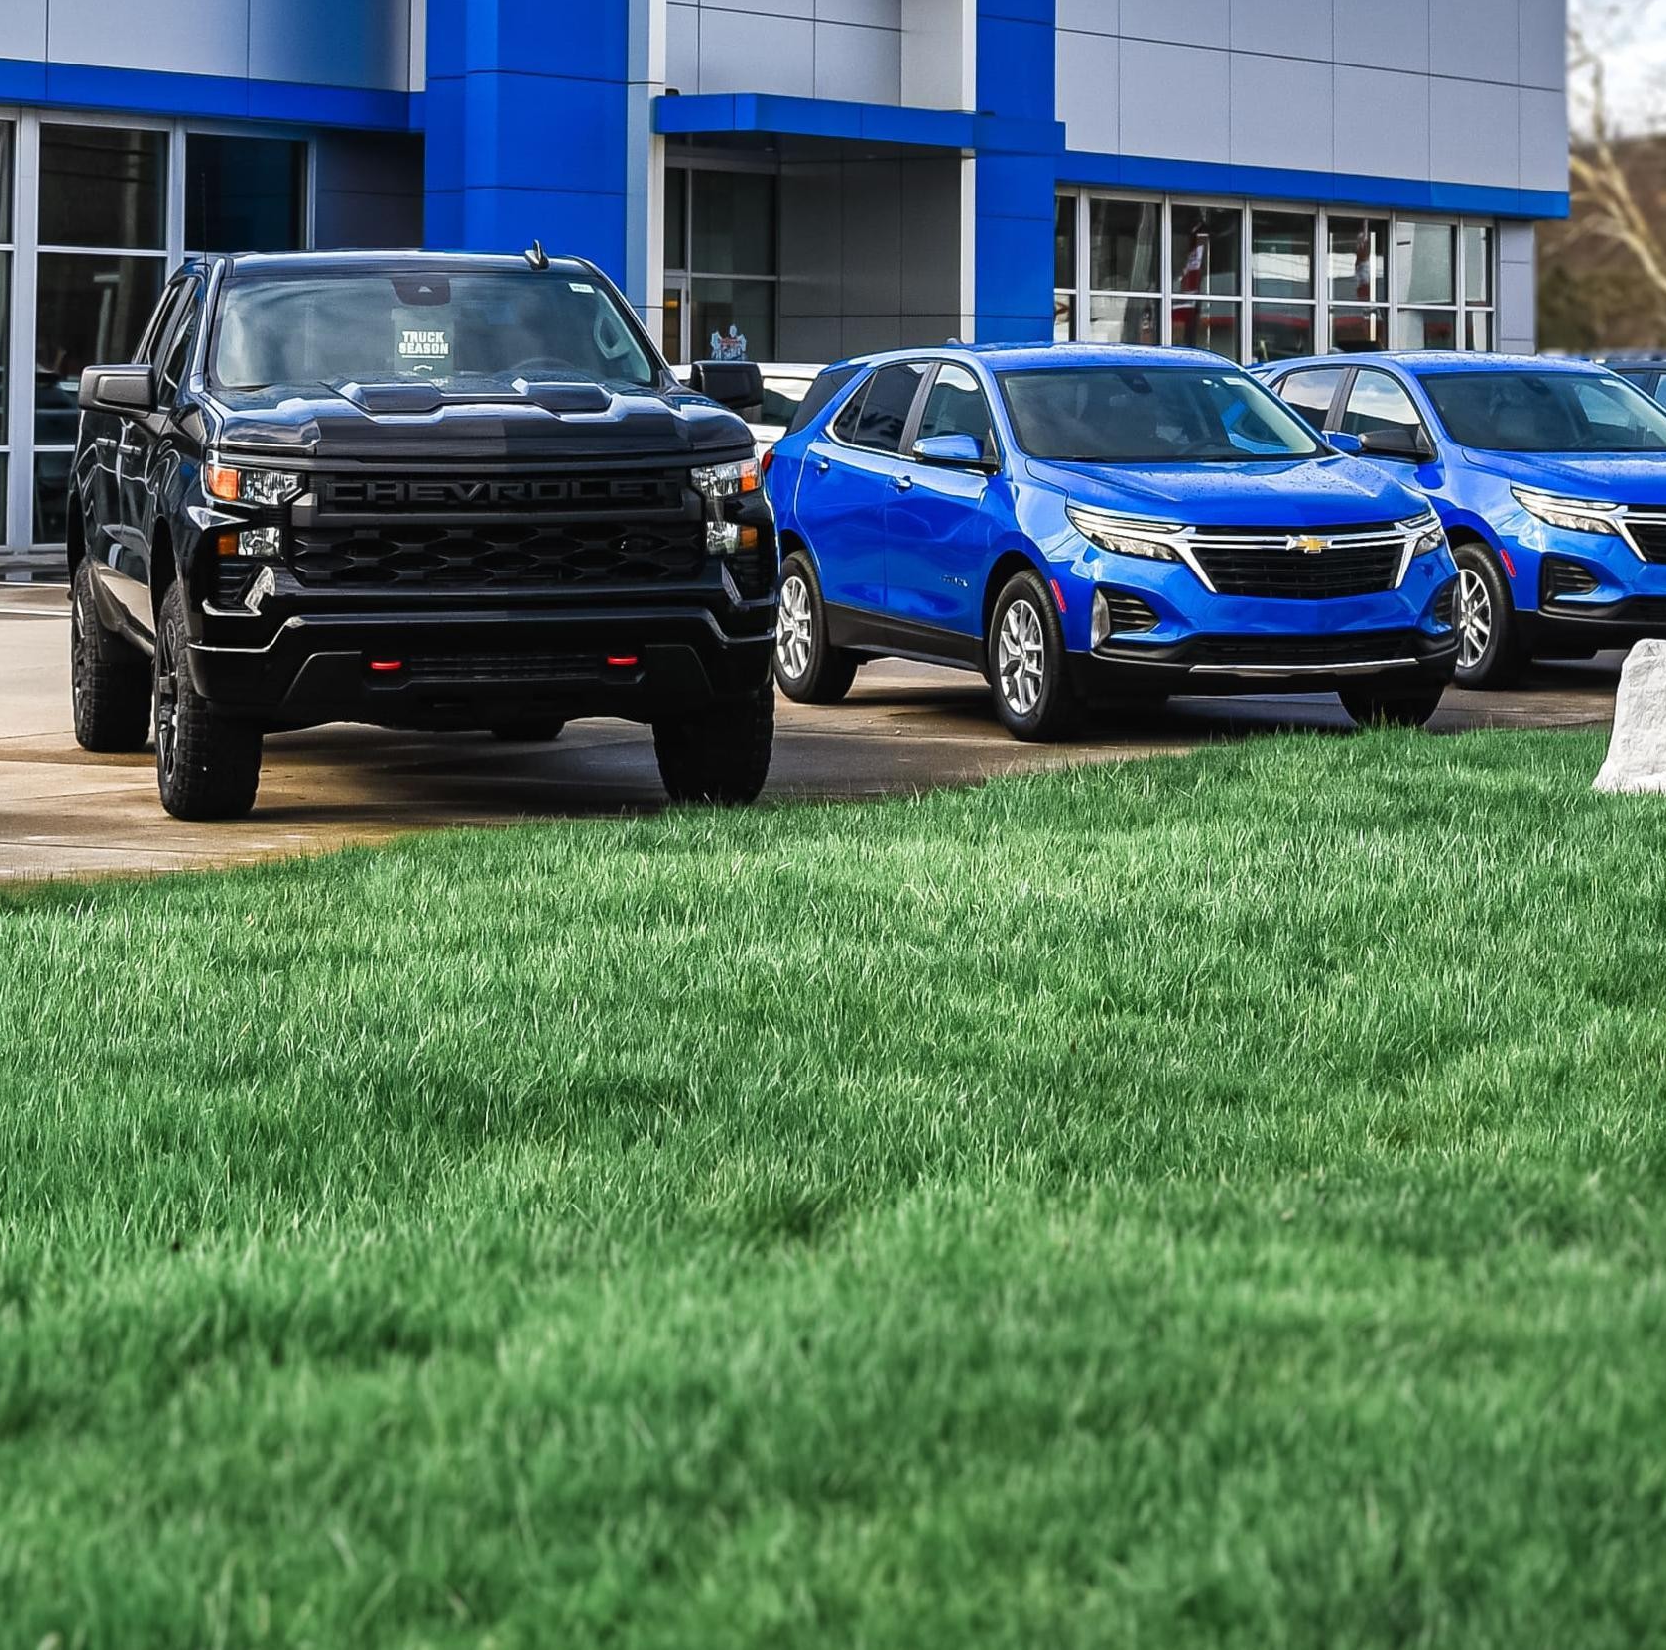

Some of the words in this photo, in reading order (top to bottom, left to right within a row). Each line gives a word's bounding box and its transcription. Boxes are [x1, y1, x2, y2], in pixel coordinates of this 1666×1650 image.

[401, 331, 446, 343] TRUCK
[398, 343, 449, 355] SEASON
[326, 480, 679, 504] CHEVROLET
